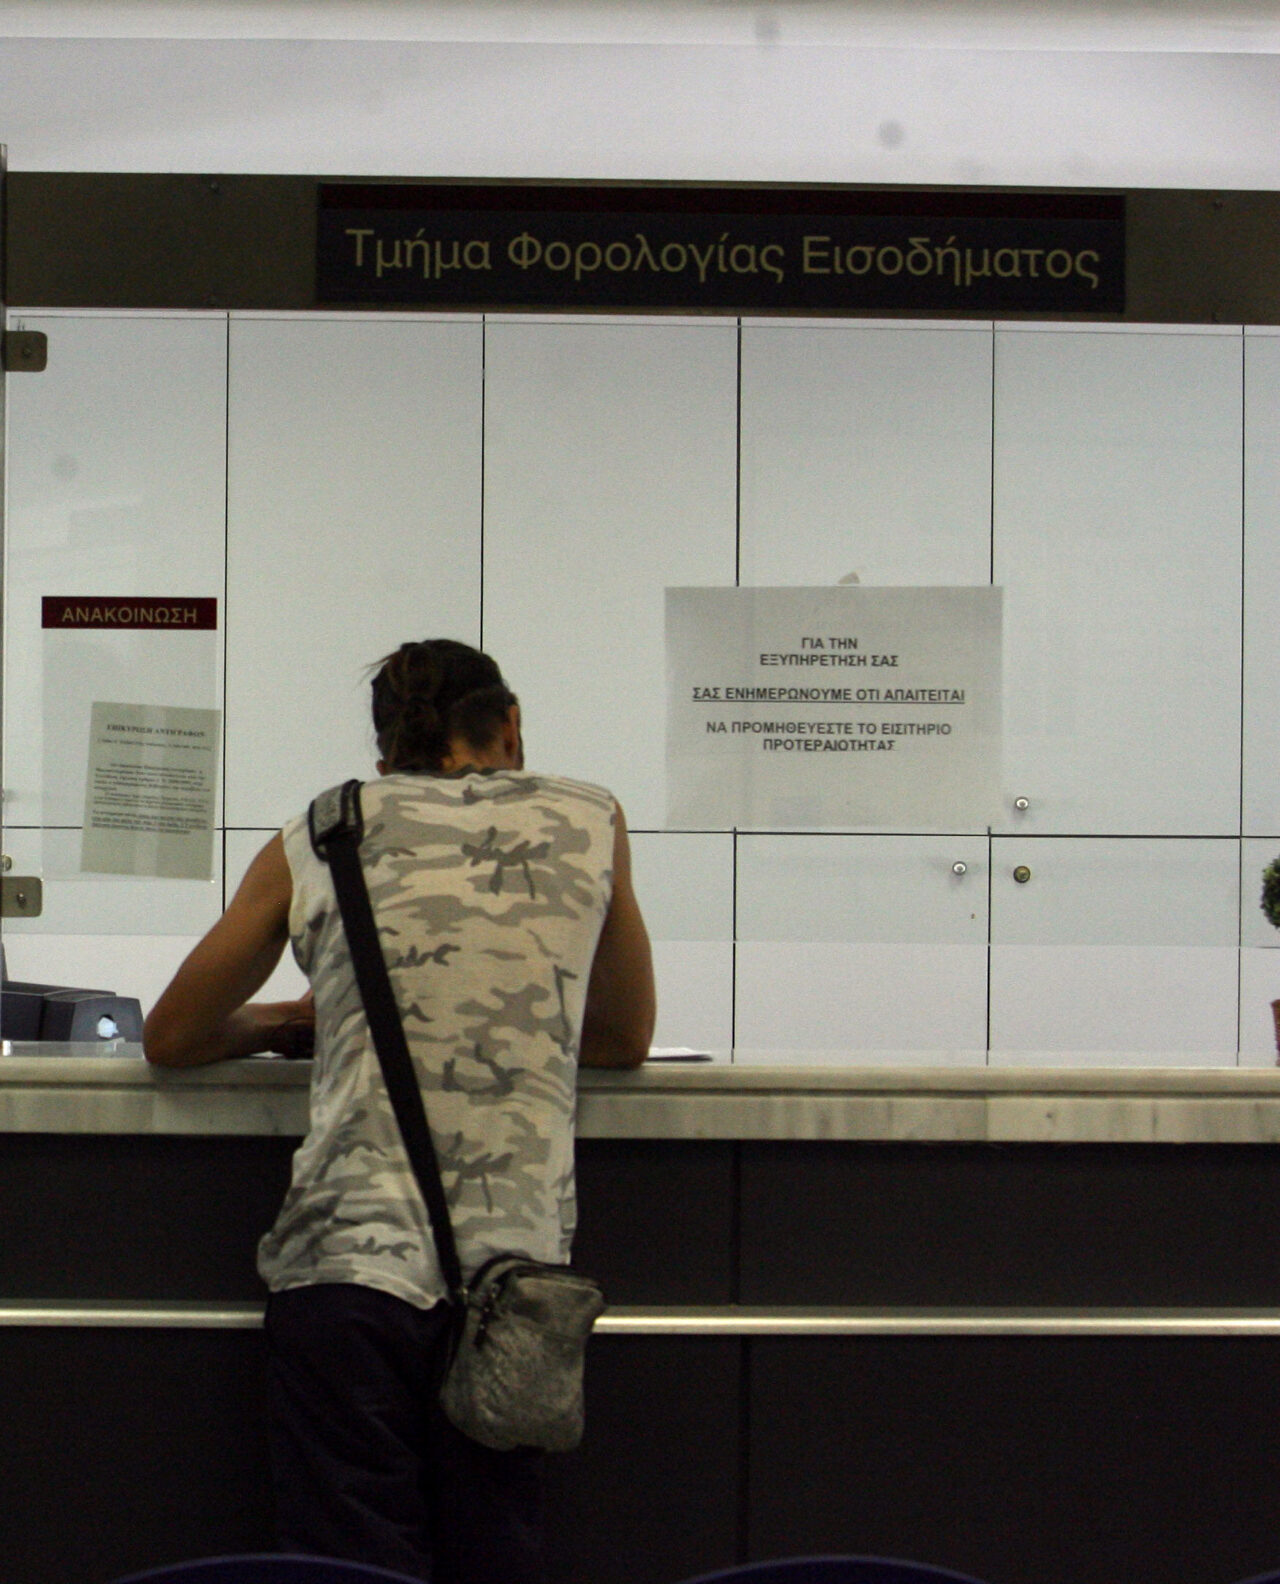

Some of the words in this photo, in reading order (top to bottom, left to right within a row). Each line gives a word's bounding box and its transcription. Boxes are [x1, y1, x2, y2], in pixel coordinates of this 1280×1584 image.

[345, 228, 492, 279] Τμήμα
[507, 231, 785, 283] Φορολογίας
[802, 235, 1100, 289] Εισοδήματος
[61, 606, 198, 624] ΑΝΑΚΟΙΝΩΣΗ
[801, 637, 824, 650] ΓΙΑ
[829, 637, 858, 650] ΤΗΝ
[759, 653, 867, 667] ΕΞΥΠΗΡΕΤΗΣΗ
[871, 654, 899, 667] ΣΑΣ
[692, 687, 721, 700] ΣΑΣ
[725, 687, 852, 700] ΕΝΗΜΕΡΩΝΟΥΜΕ
[856, 688, 880, 701] ΟΤΙ
[884, 689, 965, 701] ΑΠΑΙΤΕΙΤΑΙ
[706, 721, 727, 734] ΝΑ
[731, 721, 853, 735] ΠΡΟΜΗΘΕΥΕΣΤΕ
[857, 723, 877, 735] ΤΟ
[881, 723, 952, 736] ΕΙΣΙΤΗΡΙΟ
[763, 738, 896, 751] ΠΡΟΤΕΡΑΙΟΤΗΤΑΣ
